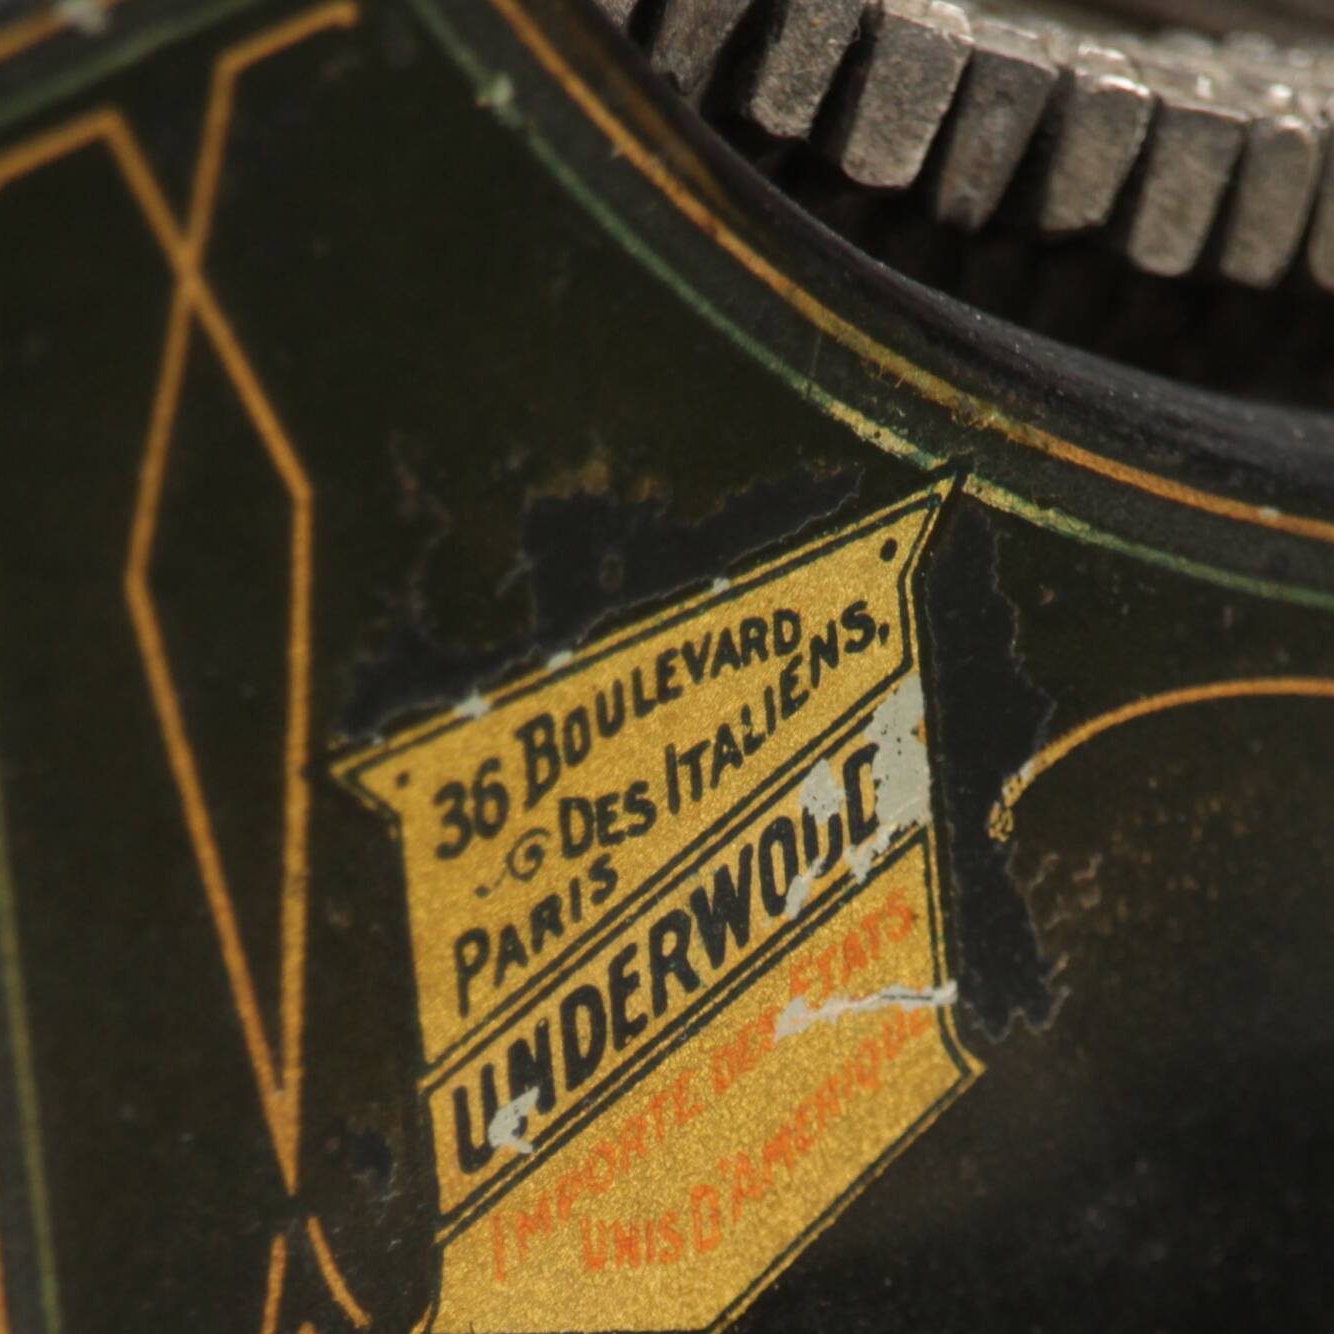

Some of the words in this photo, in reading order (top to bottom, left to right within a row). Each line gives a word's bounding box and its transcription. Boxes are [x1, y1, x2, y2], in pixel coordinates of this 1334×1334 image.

[433, 757, 510, 860] 36
[514, 608, 802, 812] BOULEVARD
[558, 781, 657, 860] DES
[453, 853, 619, 1018] PARIS
